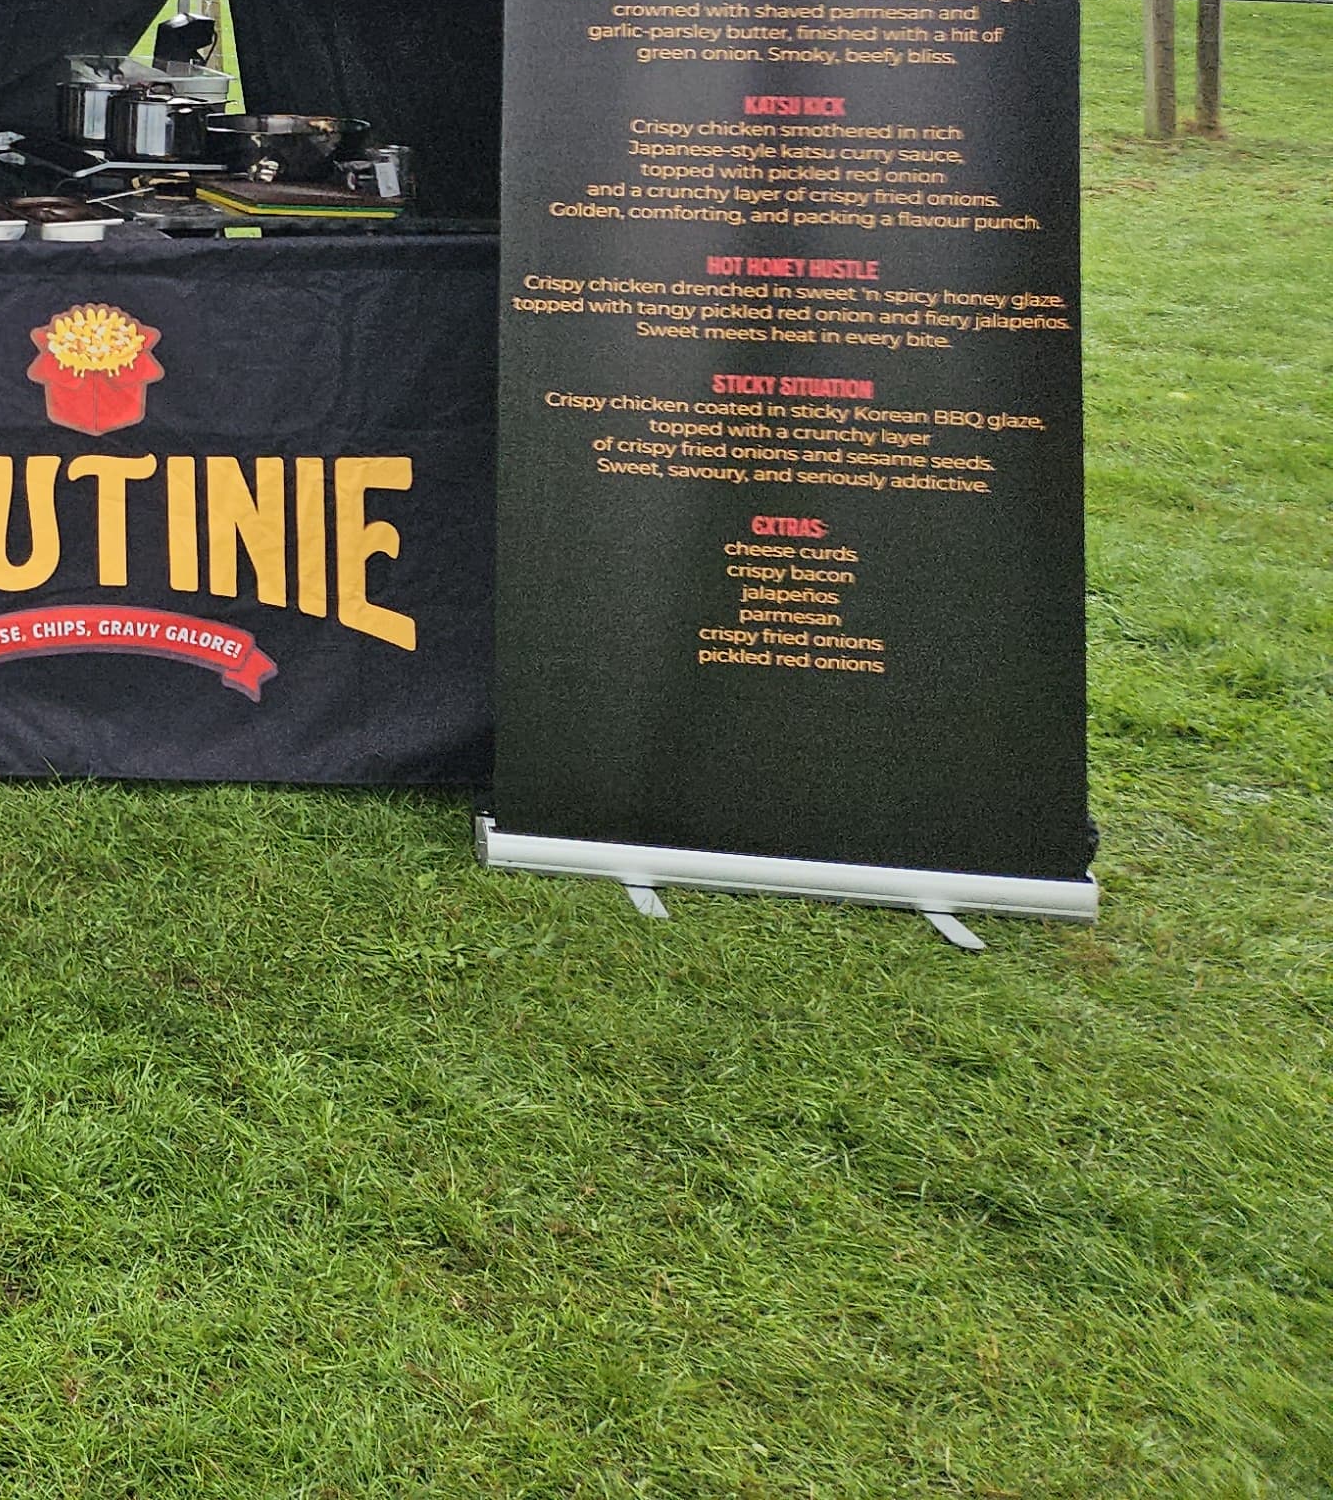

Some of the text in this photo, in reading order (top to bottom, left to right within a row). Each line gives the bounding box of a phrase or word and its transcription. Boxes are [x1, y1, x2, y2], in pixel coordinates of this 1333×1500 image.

[636, 46, 696, 63] green
[844, 47, 902, 67] beefy
[706, 255, 880, 280] HOT HONEY HUSTLE
[711, 373, 875, 399] STICKY SITUATION
[544, 391, 606, 412] Crispy
[610, 394, 689, 413] chicken
[694, 401, 762, 417] coated
[767, 402, 786, 417] in
[790, 403, 849, 424] sticky
[853, 406, 929, 424] Korean
[933, 409, 983, 429] BBQ
[724, 541, 859, 562] cheese curds
[726, 563, 856, 583] crispy bacon
[741, 584, 840, 604] jalapeños
[739, 608, 842, 627] parmesan
[32, 620, 92, 639] CHIPS,
[98, 619, 160, 638] GRAVY
[165, 624, 243, 659] GALORE!
[698, 626, 884, 651] crispy fried onions
[698, 647, 885, 673] pickled red onions
